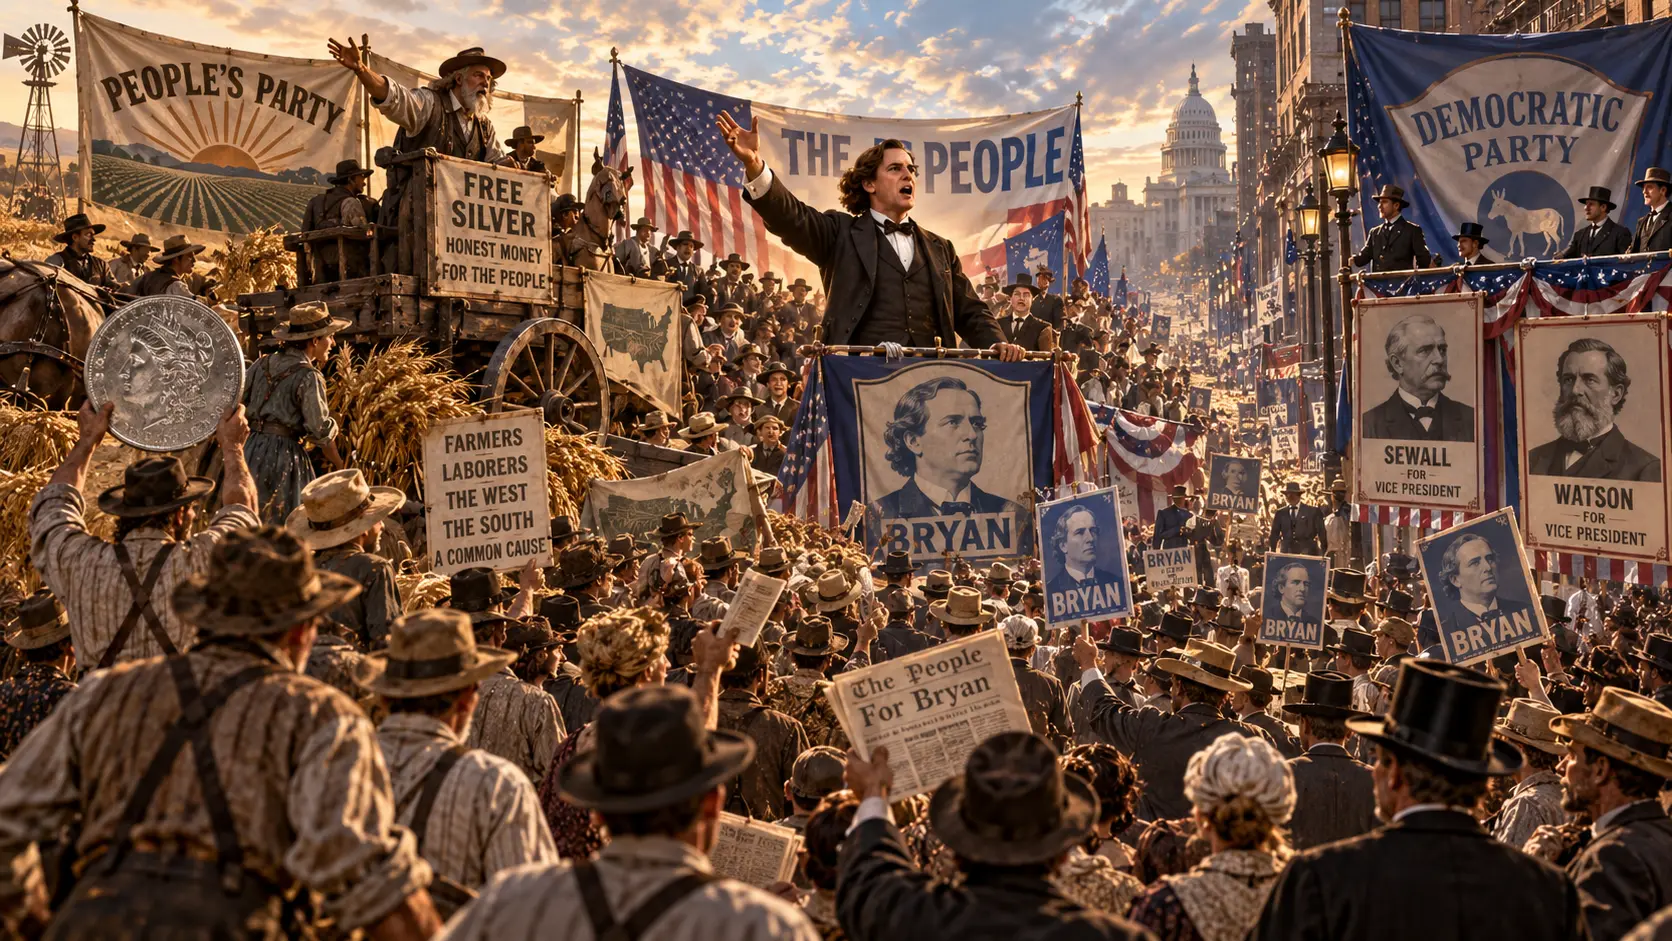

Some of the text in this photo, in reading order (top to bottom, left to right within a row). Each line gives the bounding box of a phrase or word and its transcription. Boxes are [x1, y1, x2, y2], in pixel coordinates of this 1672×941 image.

[100, 62, 345, 134] PEOPLE'S PARTY
[1411, 91, 1624, 147] DEMOCRATIC
[780, 126, 1065, 194] THE PEOPLE
[1462, 134, 1580, 172] PARTY
[464, 171, 523, 205] FREE
[452, 200, 536, 237] SILVER
[446, 237, 542, 264] HONEST MONEY
[442, 263, 546, 289] FOR THE PEOPLE
[445, 428, 523, 454] FARMERS
[442, 455, 528, 482] LABORERS
[1384, 445, 1452, 468] SEWALL
[1407, 469, 1426, 480] FOR
[445, 483, 528, 510] THE WEST
[1211, 492, 1255, 510] BRYAN
[1375, 481, 1462, 498] VICE PRESIDENT
[1554, 483, 1634, 511] WATSON
[443, 510, 534, 539] THE SOUTH
[1583, 511, 1606, 525] FOR
[886, 517, 1011, 555] BRYAN
[1545, 524, 1647, 547] VICE PRESIDENT
[434, 537, 547, 568] A COMMON CAUSE
[1147, 549, 1191, 568] BRYAN
[1052, 582, 1120, 616] BRYAN
[1265, 619, 1317, 640] BRYAN
[1450, 608, 1533, 656] BRYAN
[851, 648, 983, 700] The People
[859, 701, 904, 727] For
[911, 676, 991, 712] Bryan
